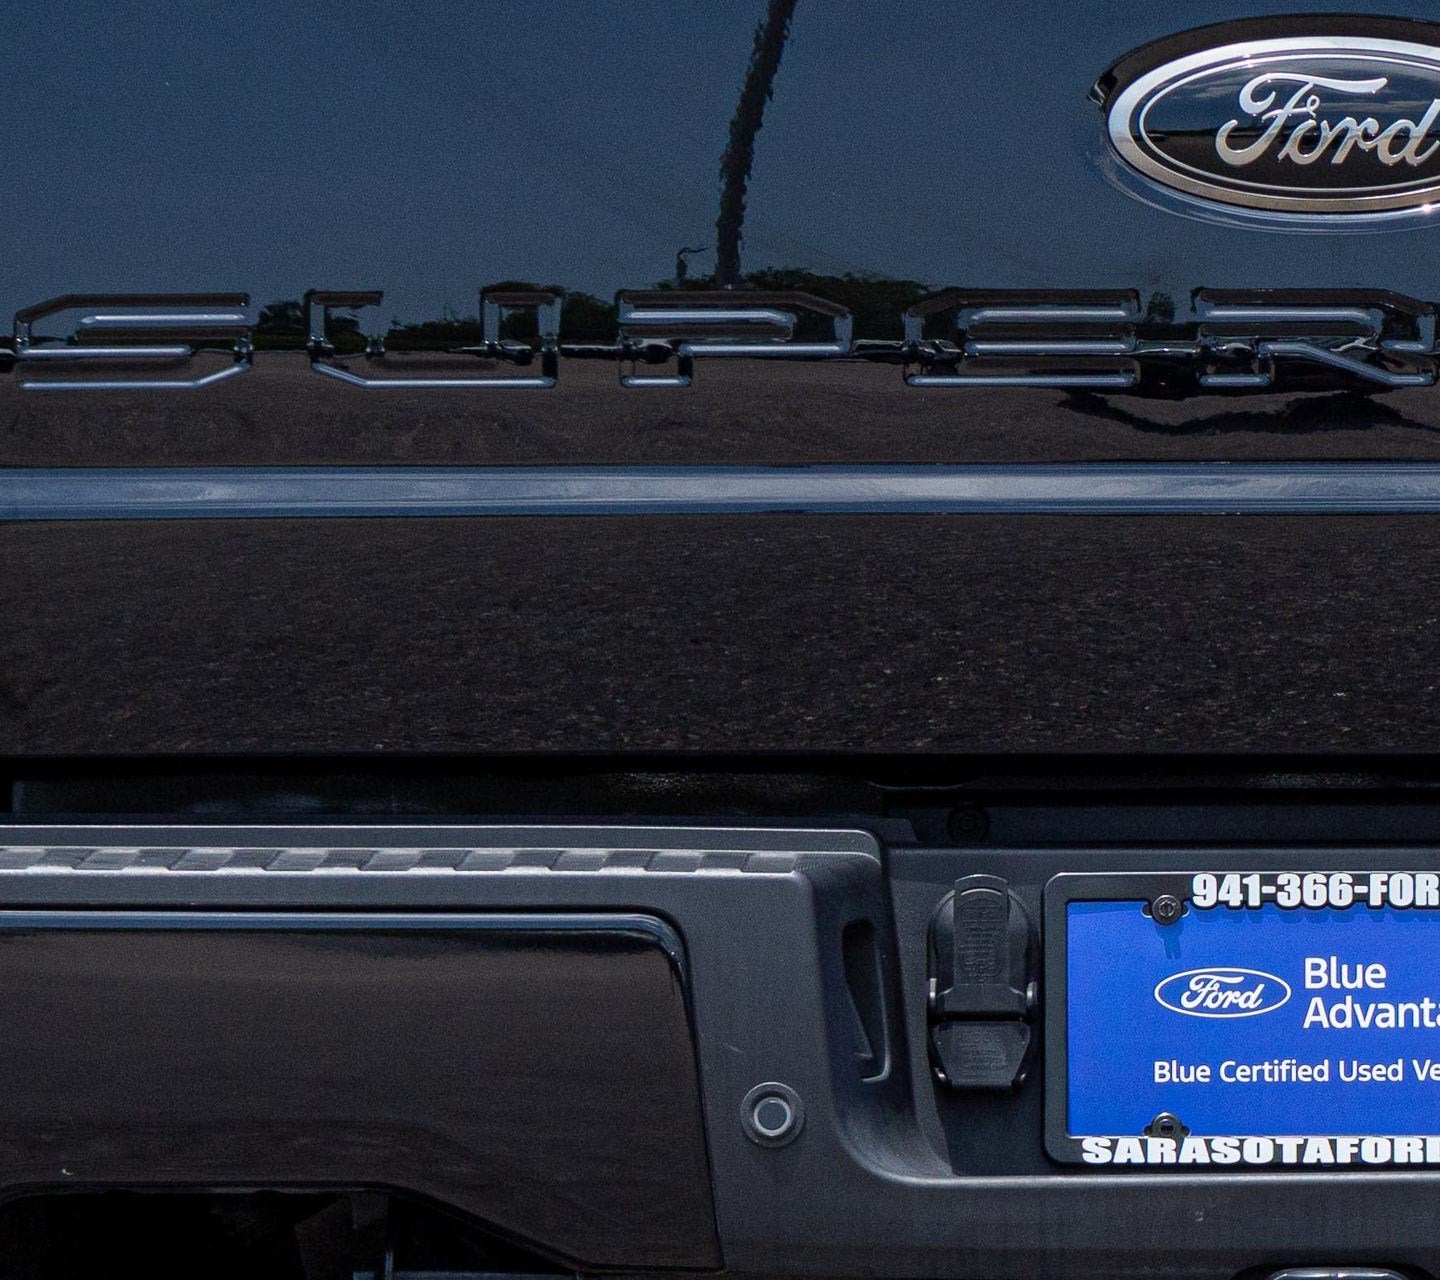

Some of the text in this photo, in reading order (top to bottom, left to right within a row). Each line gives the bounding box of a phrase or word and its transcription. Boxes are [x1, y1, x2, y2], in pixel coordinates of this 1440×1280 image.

[13, 287, 1440, 389] SUPER
[1304, 957, 1386, 989] Blue
[1180, 973, 1263, 1011] Ford
[1154, 1060, 1210, 1083] Blue
[1220, 1058, 1329, 1083] Certified
[1339, 1059, 1402, 1083] Used
